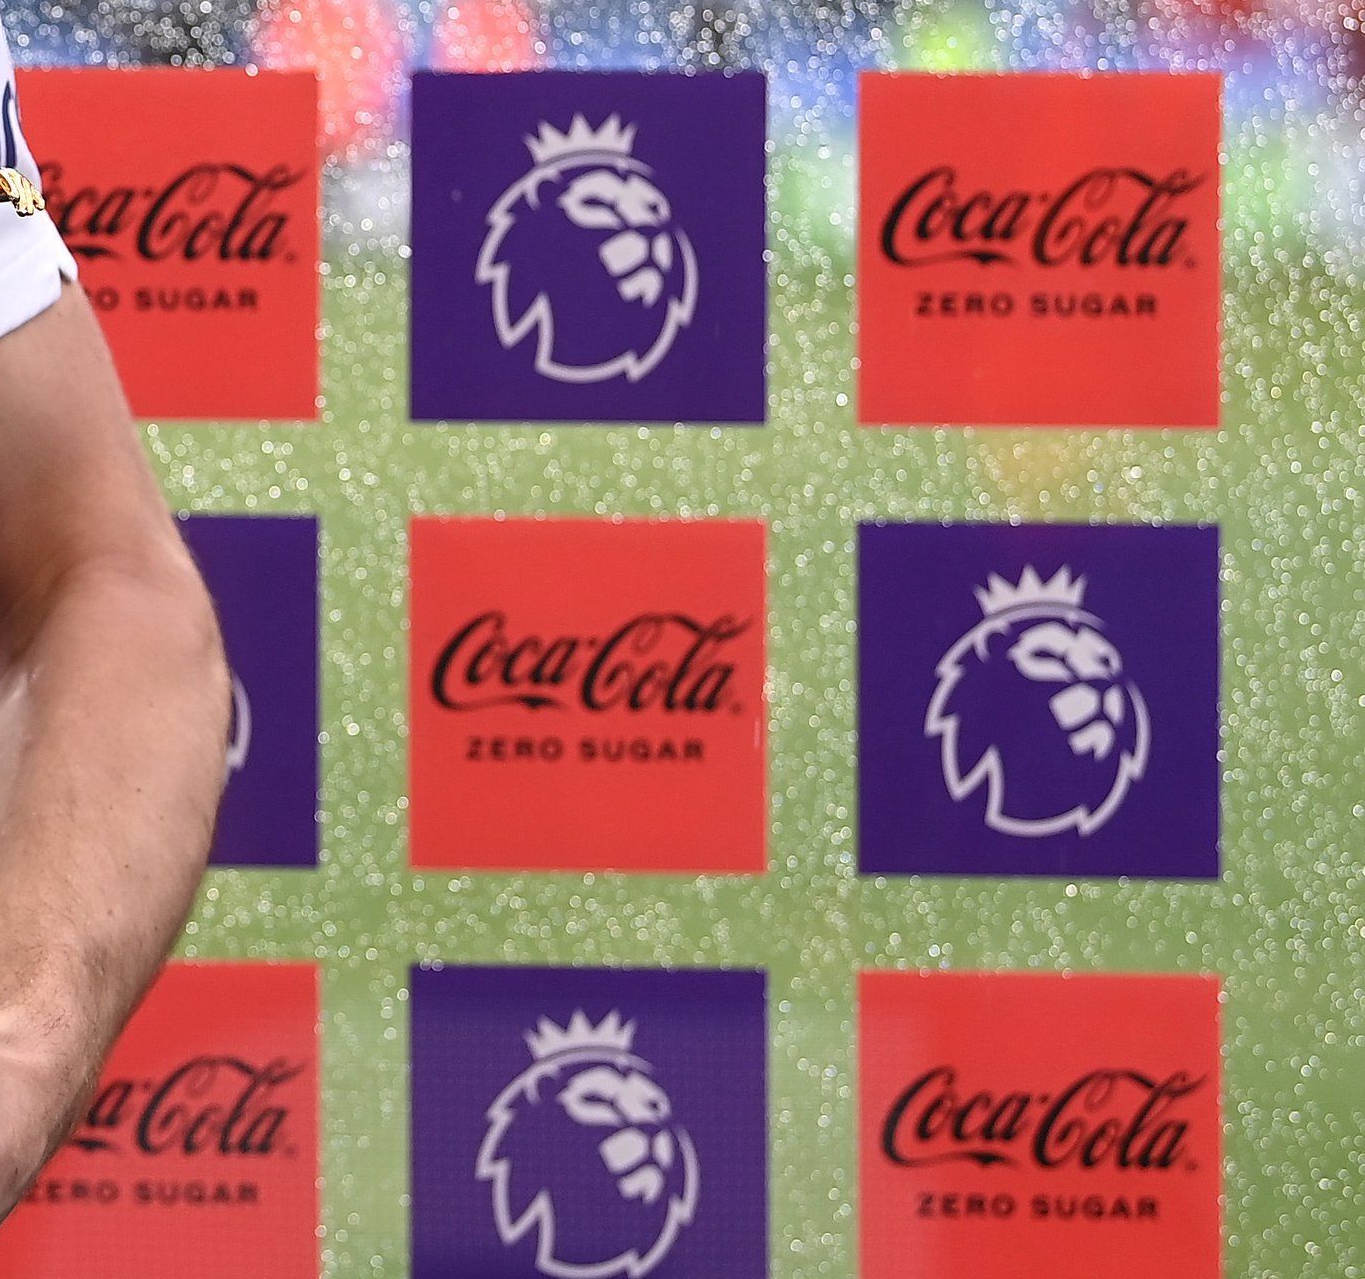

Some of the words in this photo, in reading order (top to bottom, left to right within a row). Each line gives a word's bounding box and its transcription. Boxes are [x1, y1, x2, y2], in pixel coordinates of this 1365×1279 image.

[878, 167, 1205, 269] Coca-Cola
[135, 287, 258, 311] SUGAR
[916, 292, 1015, 317] ZERO
[1030, 292, 1157, 317] SUGAR
[429, 611, 751, 714] Coca-Cola
[466, 737, 564, 762] ZERO
[579, 737, 704, 762] SUGAR
[66, 1055, 304, 1155] a-Cola
[879, 1066, 1207, 1172] Coca-Cola
[134, 1180, 259, 1205] SUGAR
[917, 1193, 1017, 1220] ZERO
[1031, 1193, 1159, 1220] SUGAR
